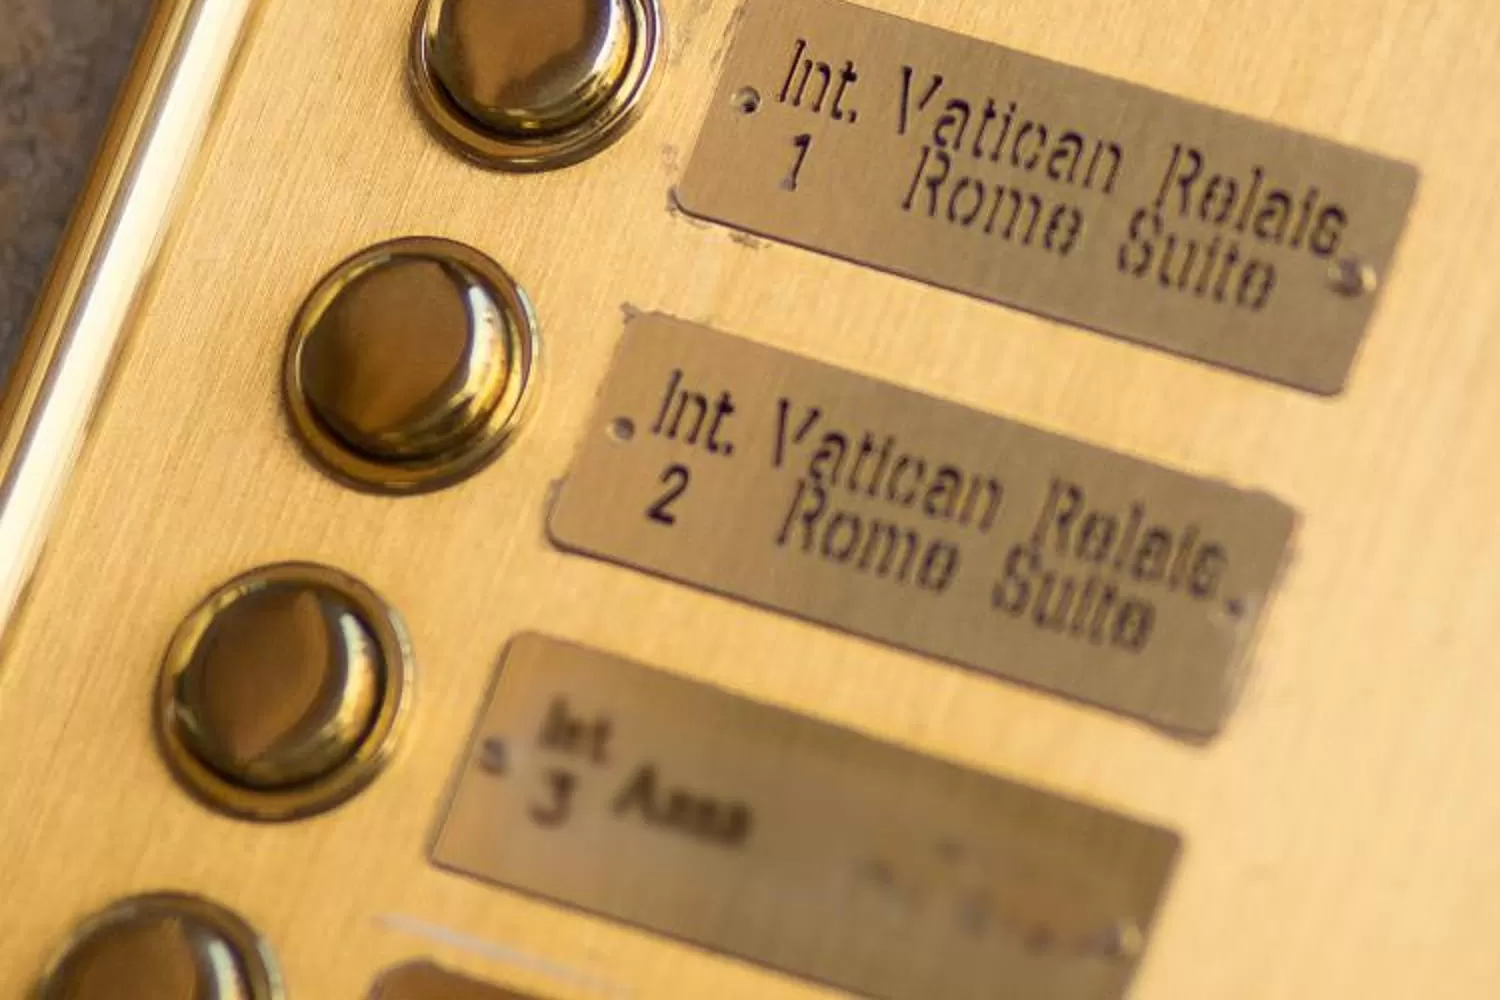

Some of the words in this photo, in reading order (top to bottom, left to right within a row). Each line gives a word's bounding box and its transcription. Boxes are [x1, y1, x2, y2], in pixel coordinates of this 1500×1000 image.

[779, 38, 858, 124] Int.
[895, 64, 1124, 195] Vatican
[1153, 142, 1349, 257] Relais
[780, 132, 813, 193] 1
[901, 145, 1083, 257] Rome
[1117, 206, 1277, 311] Suite
[647, 464, 690, 526] 2
[777, 477, 960, 597] Rome
[991, 542, 1157, 653] Suite
[649, 368, 735, 457] Int.
[769, 397, 1005, 533] Vatican
[1031, 476, 1228, 599] Relais
